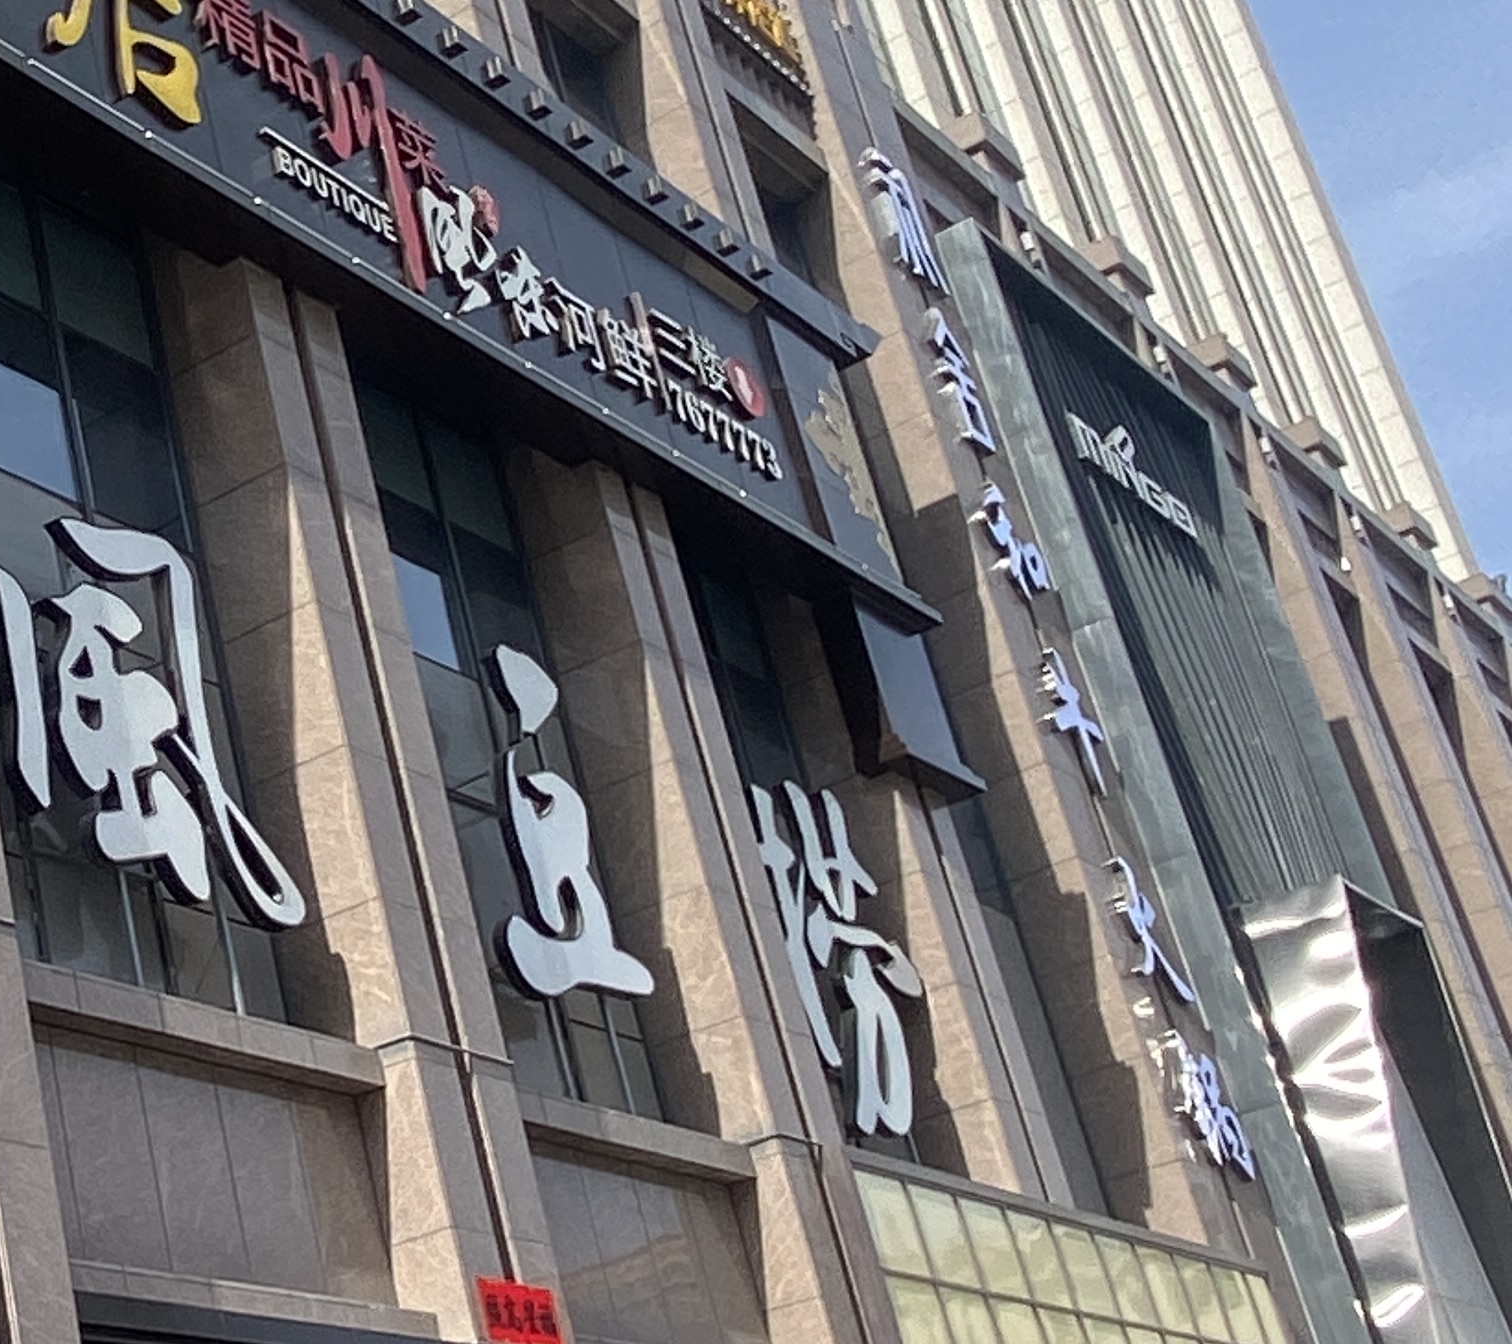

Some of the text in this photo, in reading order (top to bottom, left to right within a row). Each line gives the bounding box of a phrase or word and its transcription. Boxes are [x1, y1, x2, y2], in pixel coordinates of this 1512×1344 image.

[273, 146, 399, 244] BOUTIQUE
[646, 308, 733, 402] 三楼
[666, 379, 783, 481] 7677773
